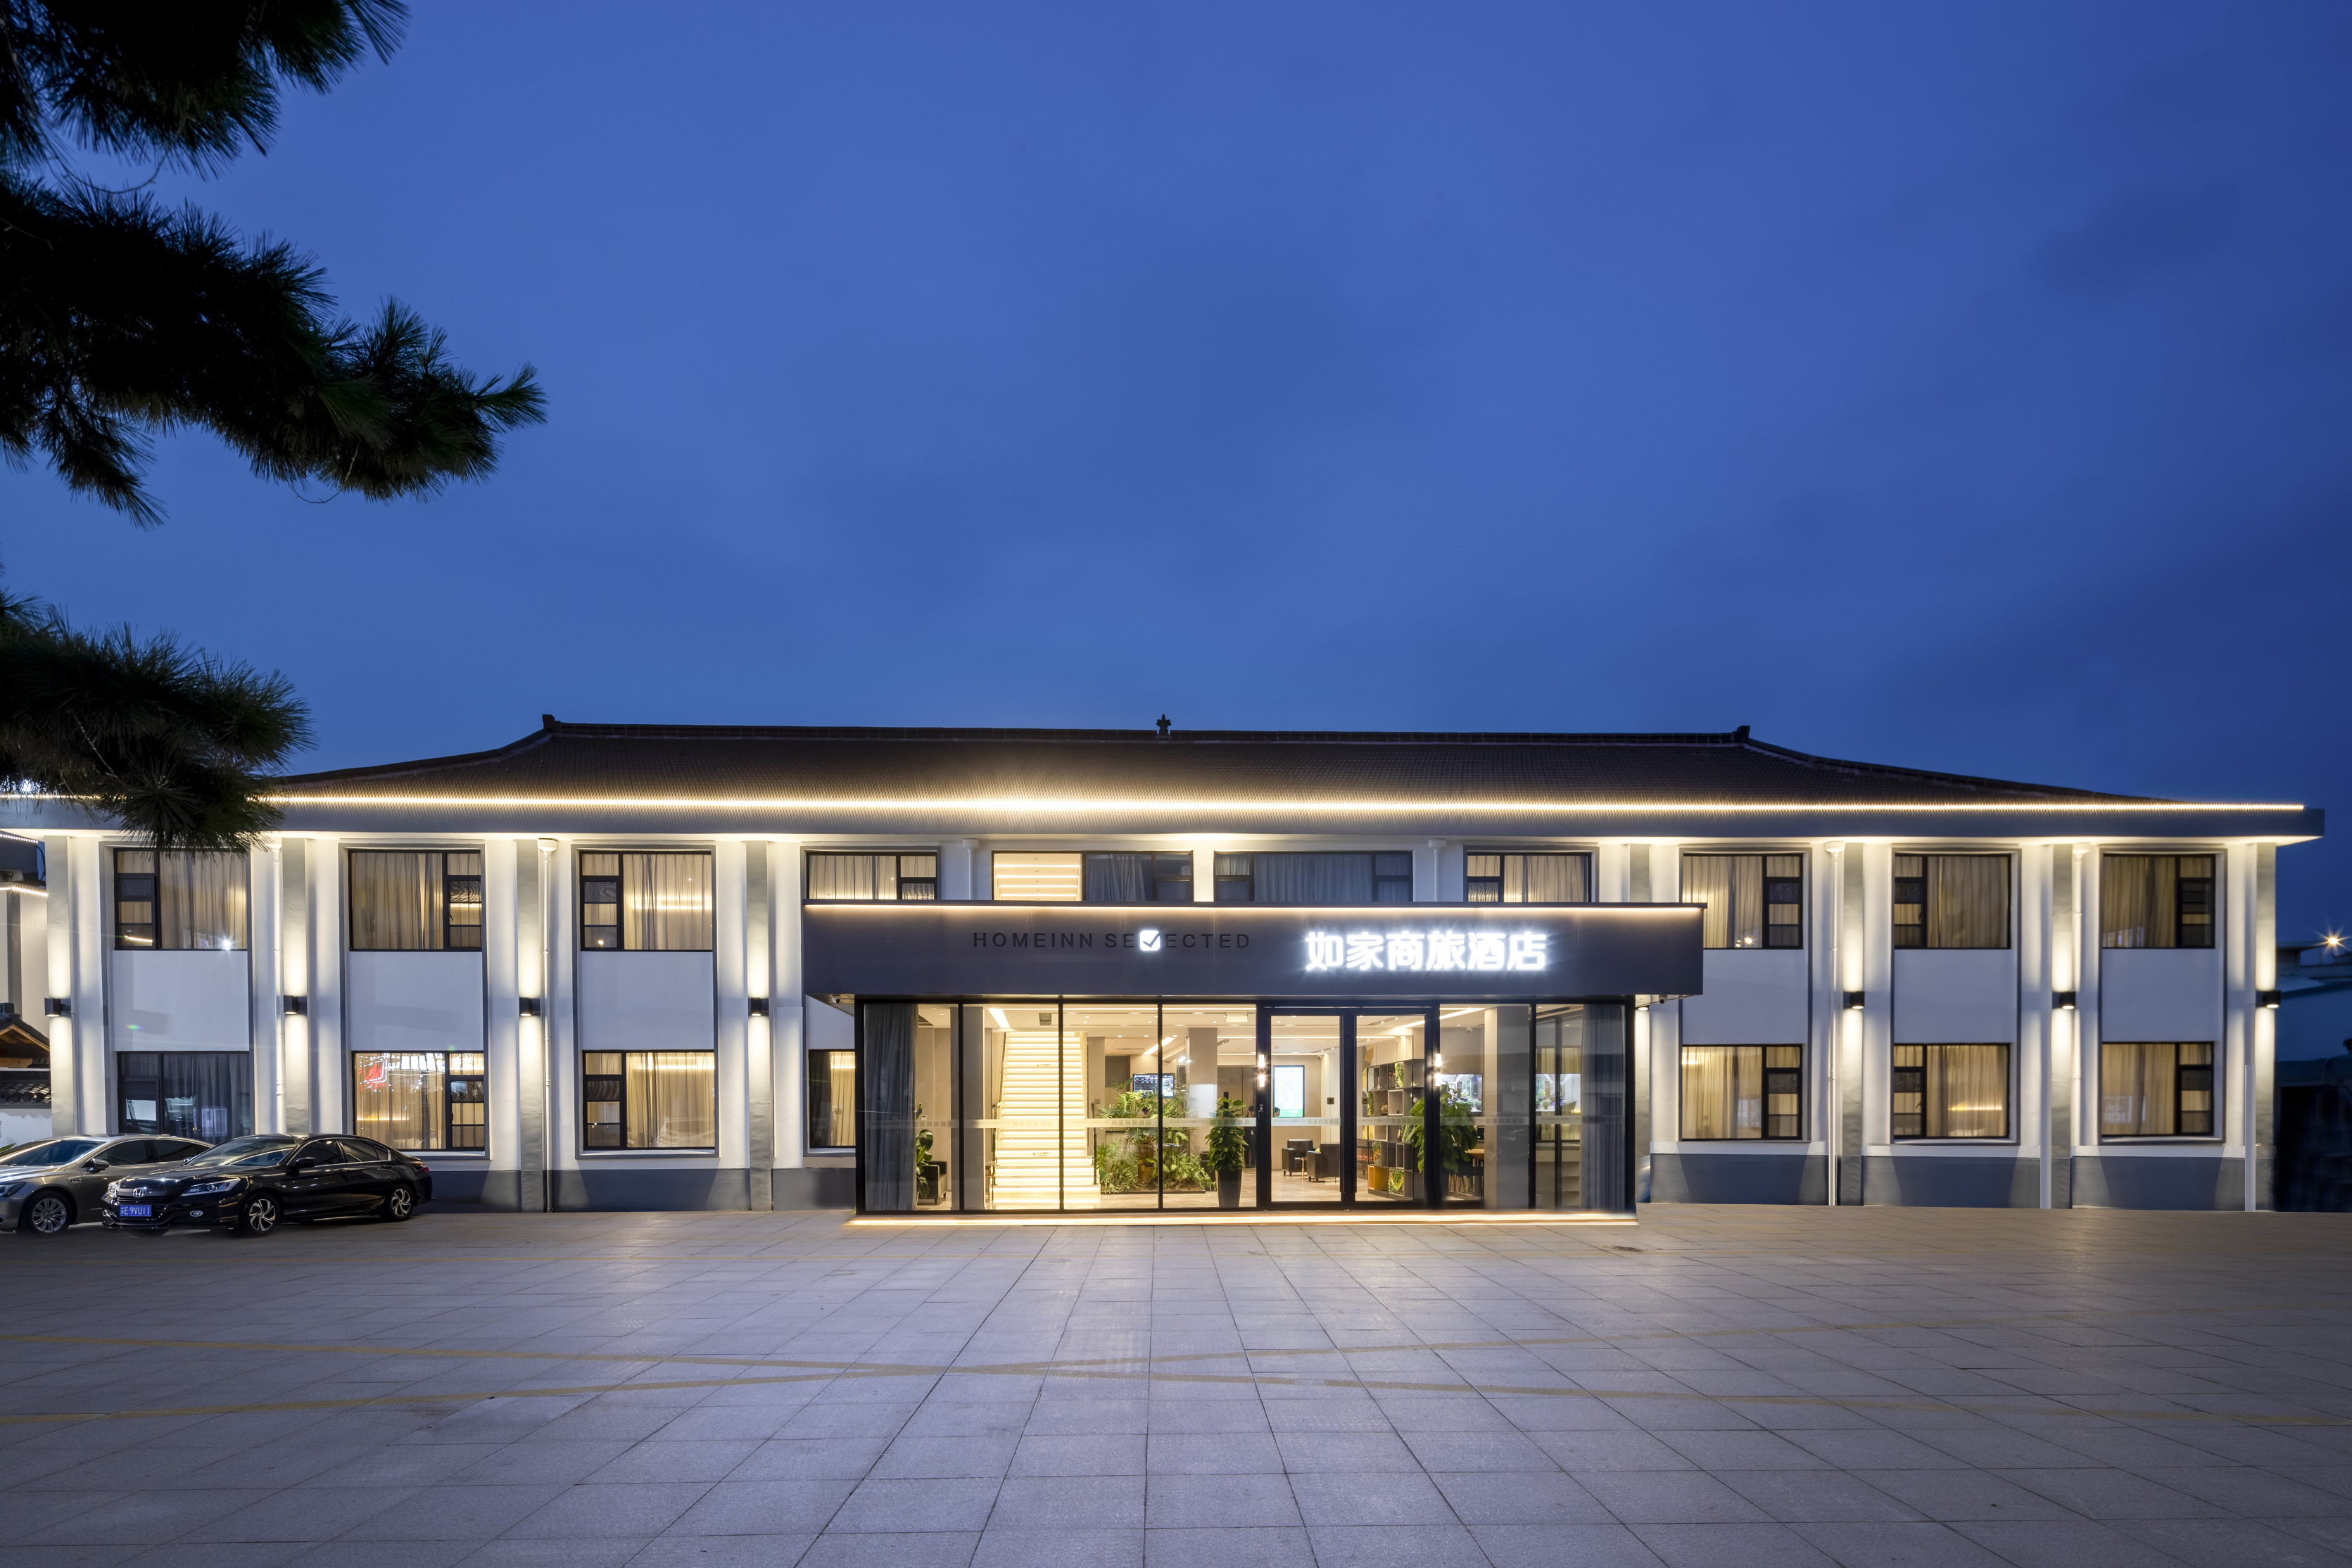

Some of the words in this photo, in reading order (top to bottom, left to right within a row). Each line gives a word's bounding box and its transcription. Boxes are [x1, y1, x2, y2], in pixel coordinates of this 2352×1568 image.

[973, 932, 1093, 948] HOMEINN
[1104, 932, 1250, 949] SEECTED
[1305, 930, 1547, 970] 如家商旅酒店
